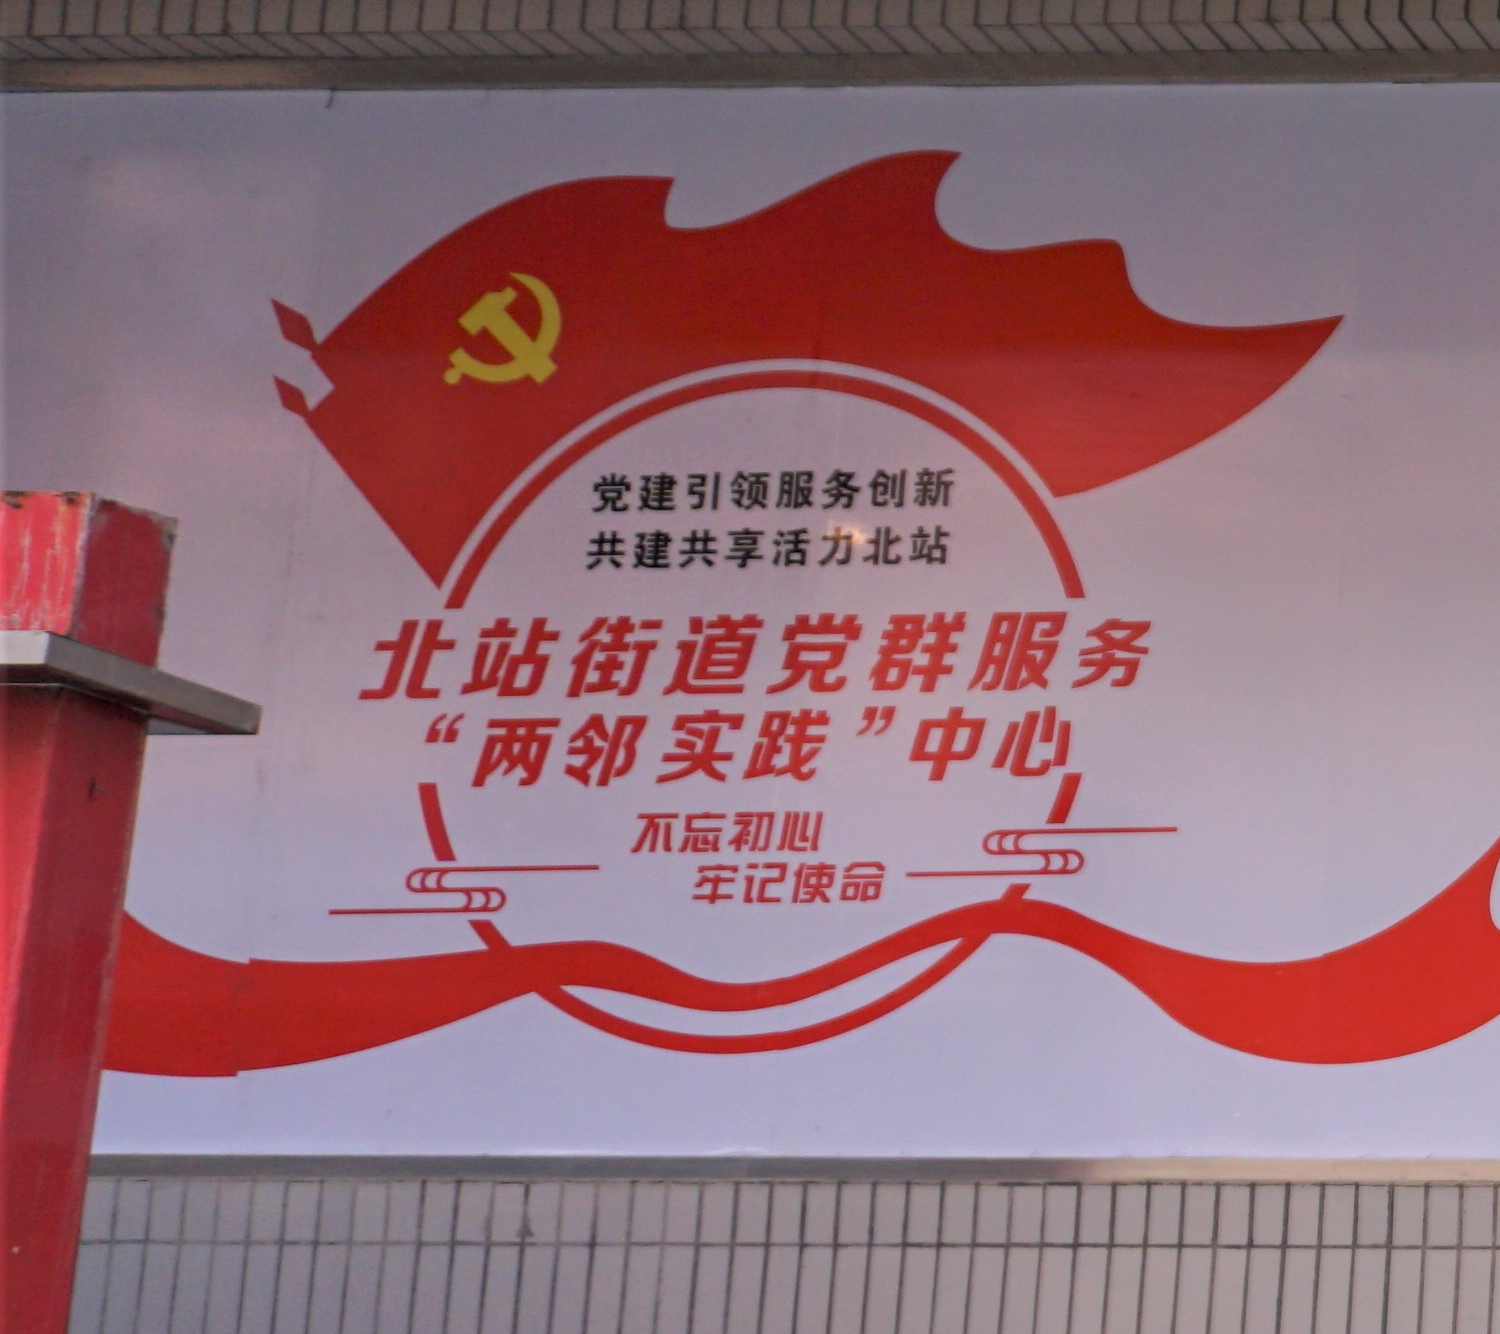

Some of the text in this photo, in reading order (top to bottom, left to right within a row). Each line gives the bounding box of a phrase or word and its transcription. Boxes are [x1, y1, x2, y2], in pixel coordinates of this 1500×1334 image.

[591, 467, 954, 513] 党建引领服务创新
[586, 525, 951, 569] 共建共享活力北站
[358, 610, 1152, 701] 北站街道党群服务
[423, 704, 1073, 789] “两邻实践”中心
[630, 810, 824, 855] 不忘初心
[692, 860, 887, 905] 牢记使命
